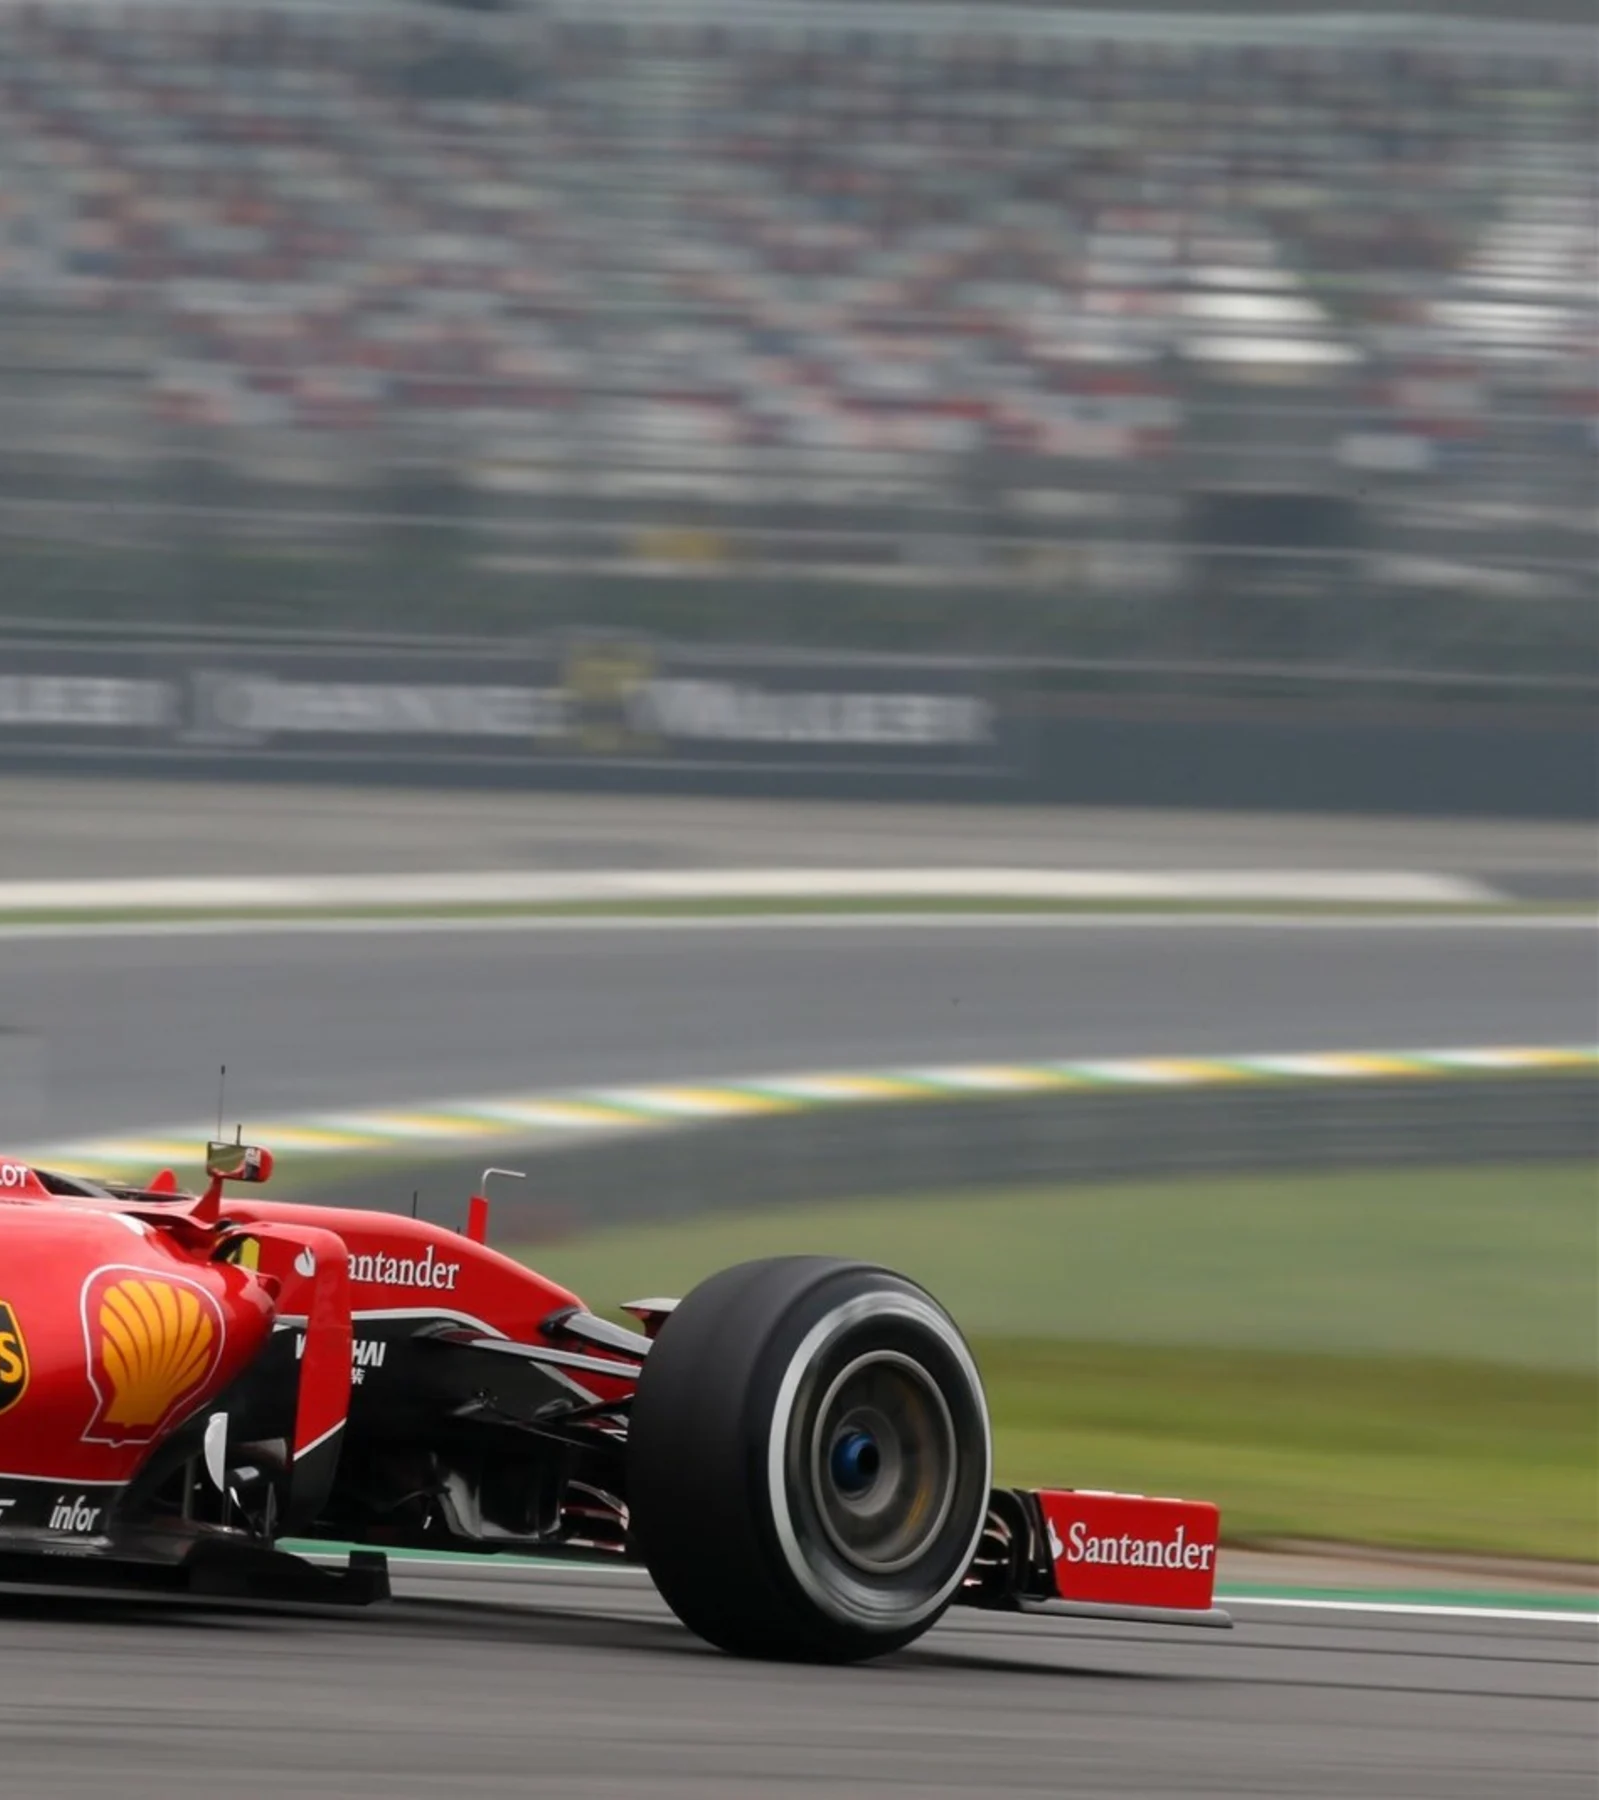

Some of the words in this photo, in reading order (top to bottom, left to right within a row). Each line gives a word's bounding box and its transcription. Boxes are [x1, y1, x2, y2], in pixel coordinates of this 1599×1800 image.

[348, 1244, 460, 1289] antander
[48, 1494, 101, 1532] infor
[1067, 1521, 1215, 1570] Santander
